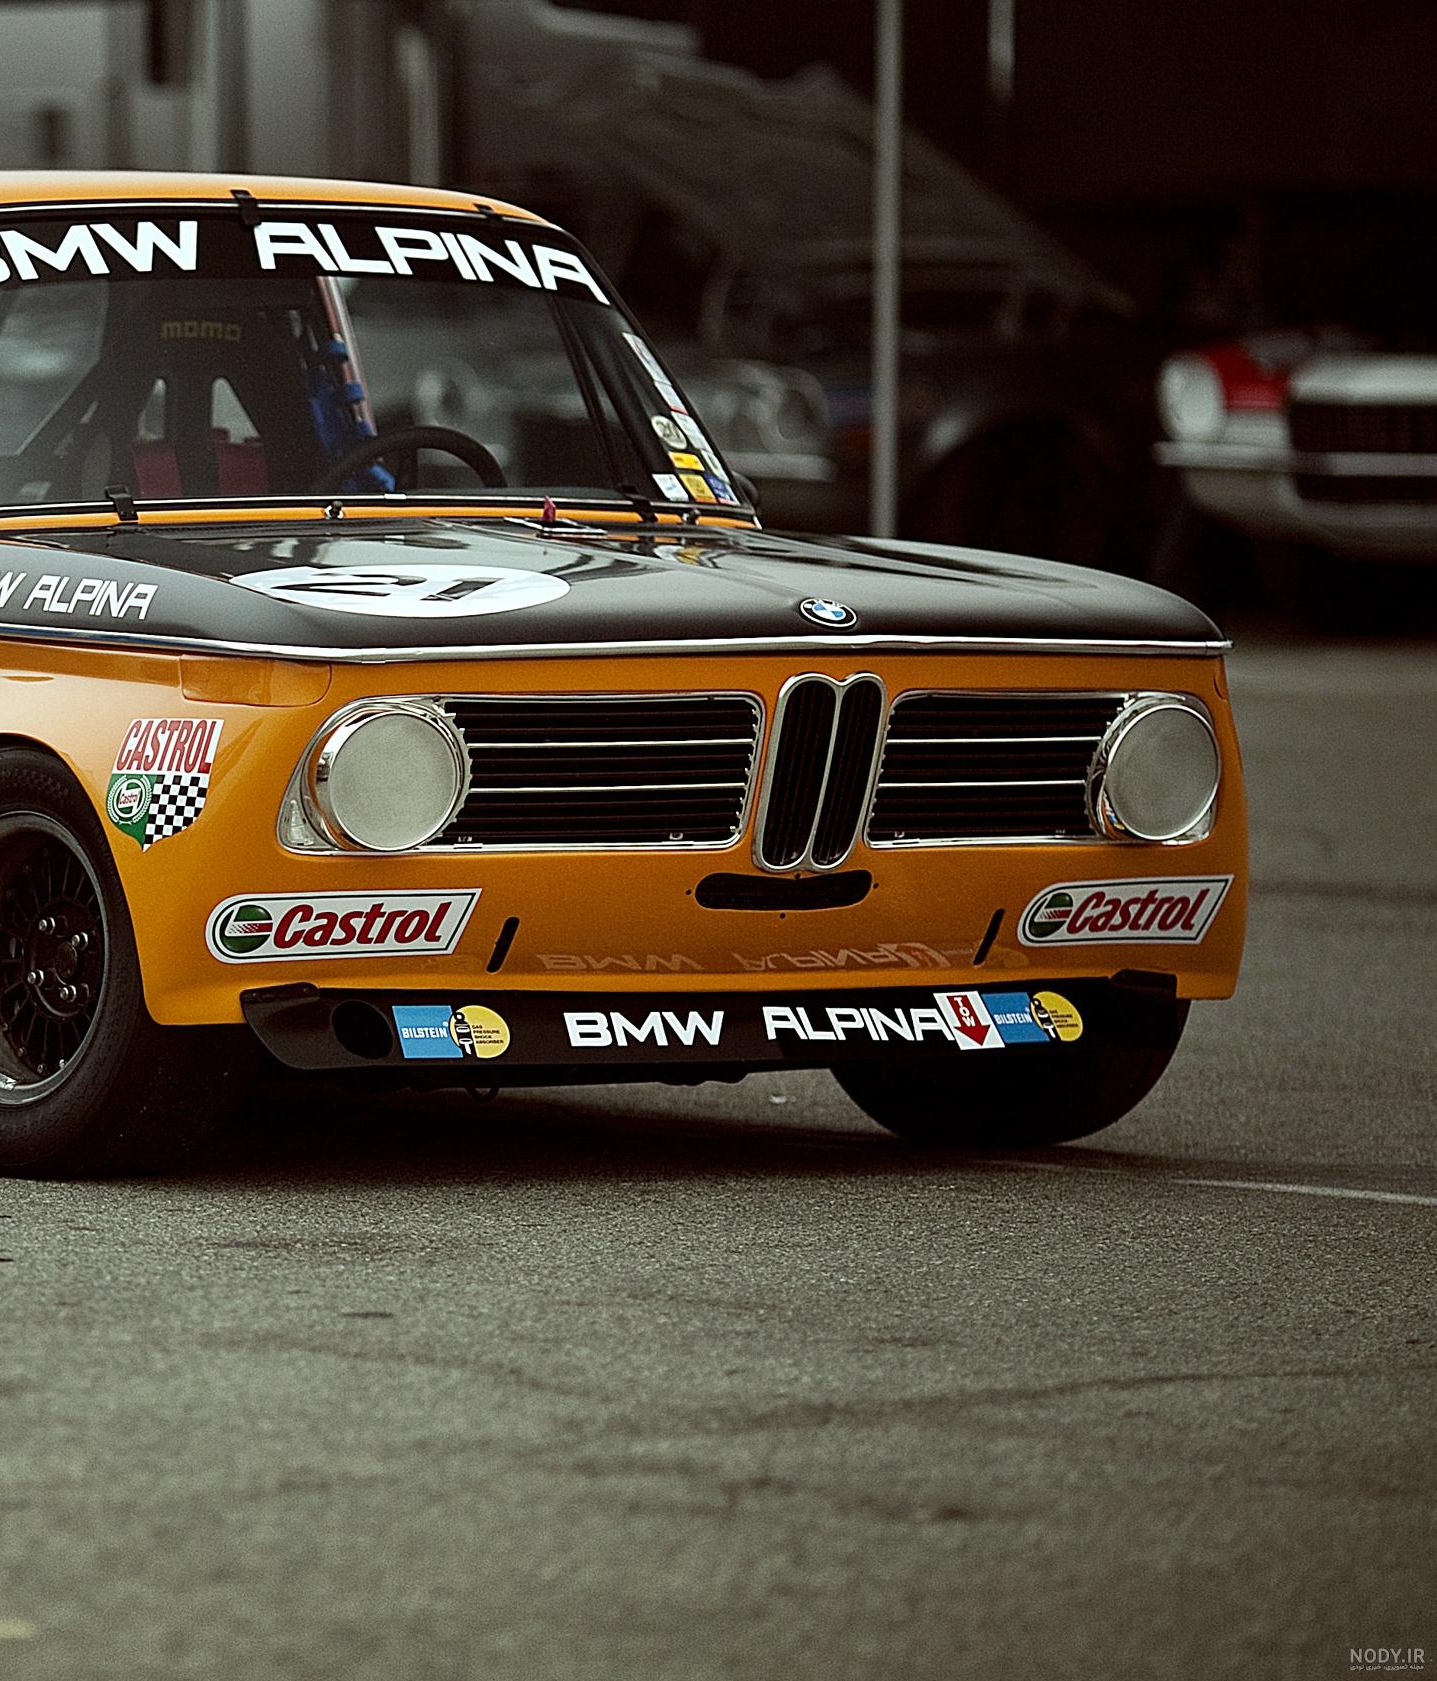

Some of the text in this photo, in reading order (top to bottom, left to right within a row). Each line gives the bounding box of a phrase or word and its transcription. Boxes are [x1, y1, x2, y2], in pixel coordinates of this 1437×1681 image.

[257, 221, 610, 305] ALPINA
[22, 574, 158, 620] ALPINA
[116, 720, 217, 774] CASTROL
[273, 901, 452, 949] Castrol
[1066, 888, 1210, 935] Castrol
[401, 1027, 447, 1039] BILSTEIN
[563, 1006, 955, 1047] BMW ALPINA
[953, 996, 976, 1028] TOW
[993, 1013, 1033, 1025] BILSTEIN
